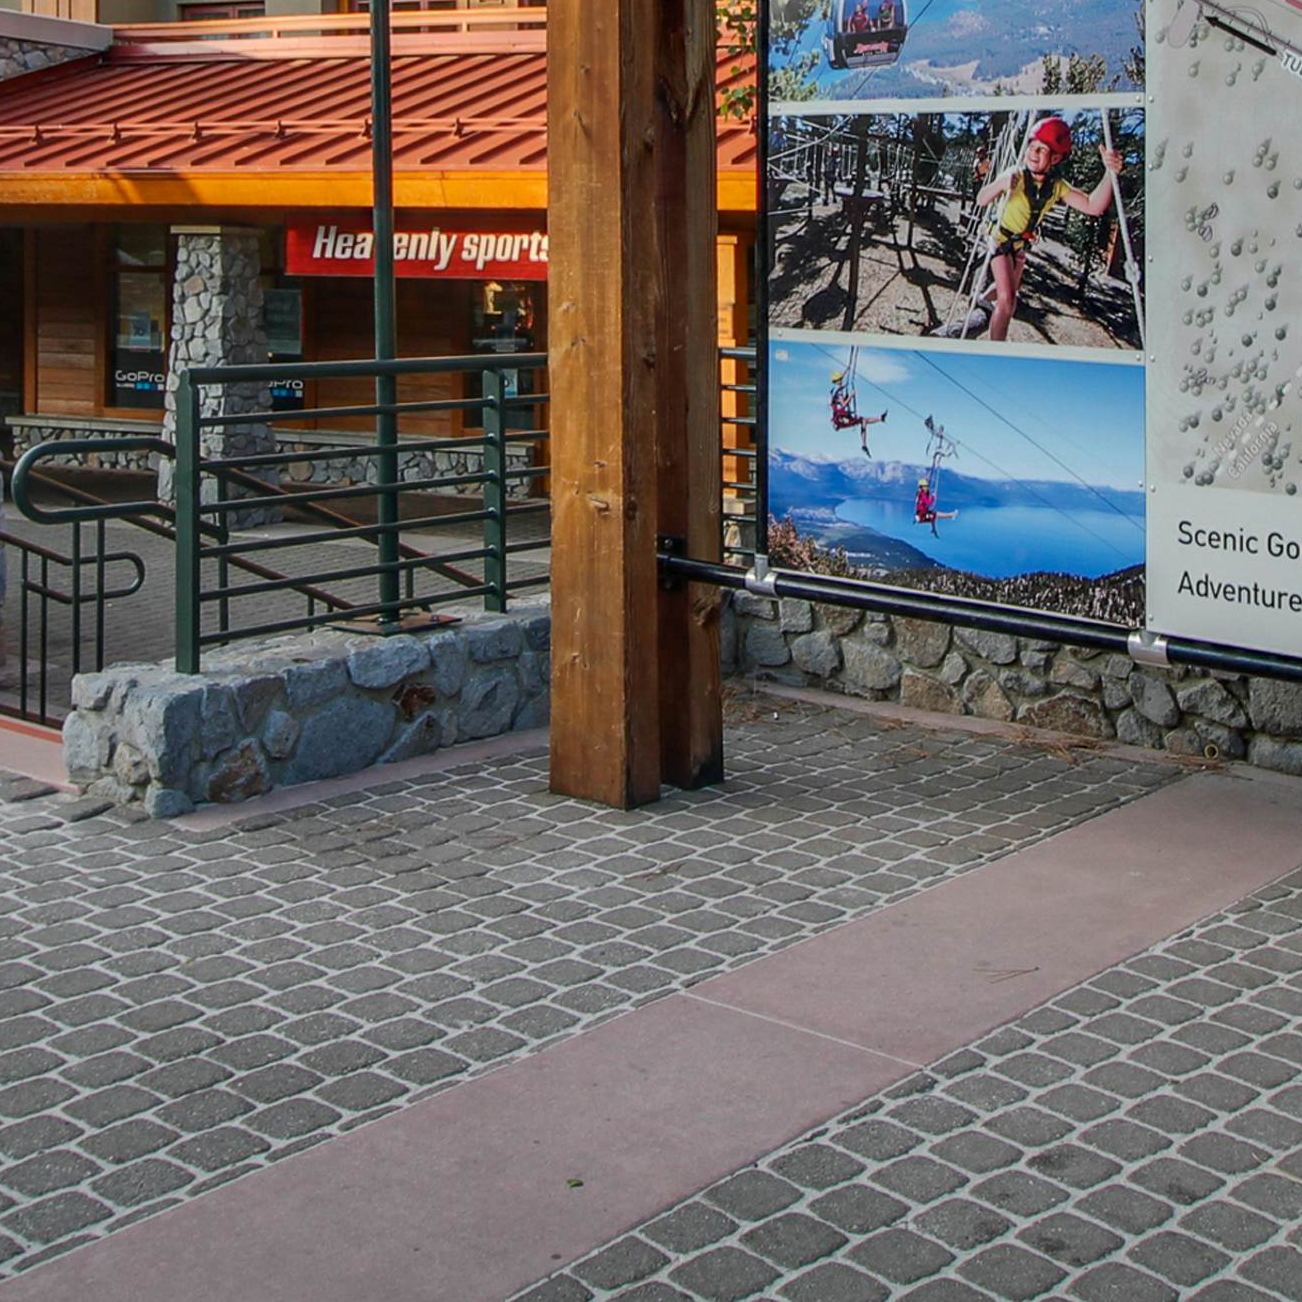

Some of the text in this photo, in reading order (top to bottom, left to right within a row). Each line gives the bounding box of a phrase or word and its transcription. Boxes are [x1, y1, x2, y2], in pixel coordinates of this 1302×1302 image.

[312, 225, 549, 270] Heaenly sports
[115, 369, 165, 383] GoPro
[1178, 520, 1258, 554] Scenic
[1177, 570, 1302, 612] Adventure
